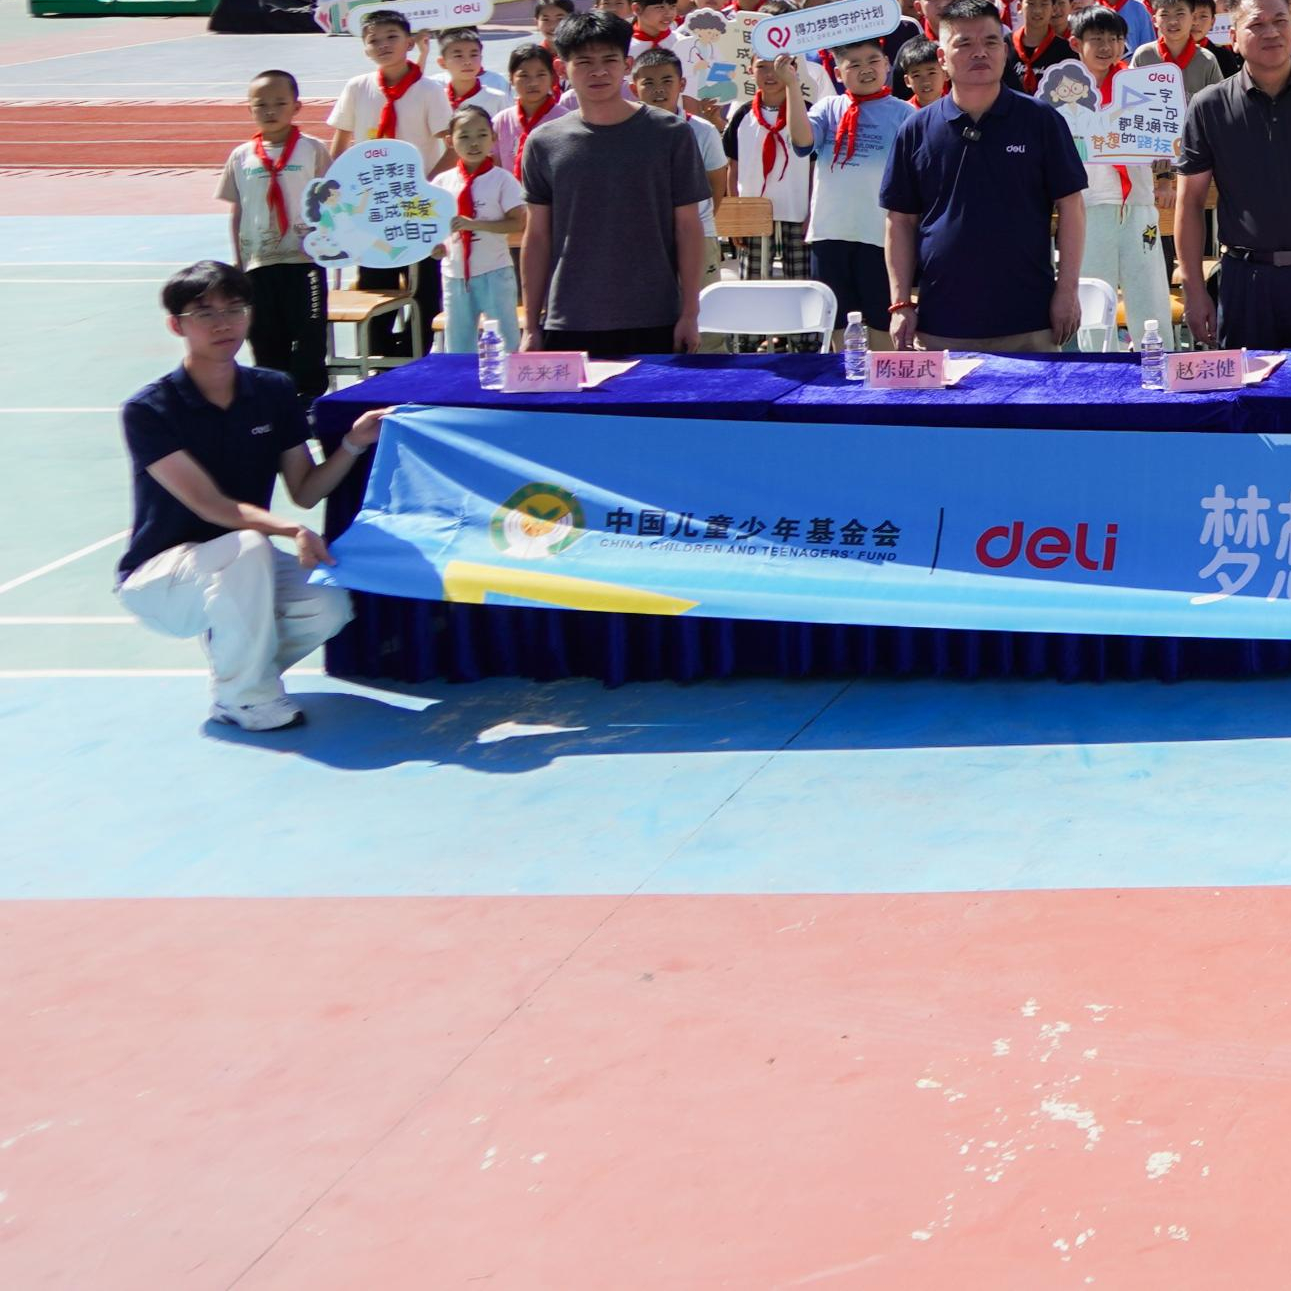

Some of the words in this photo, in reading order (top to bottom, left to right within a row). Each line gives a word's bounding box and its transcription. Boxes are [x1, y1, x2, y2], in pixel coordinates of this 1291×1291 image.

[453, 3, 480, 15] deli
[794, 5, 884, 36] 得力梦想守护计划
[1148, 72, 1174, 84] deli
[1144, 89, 1173, 104] 一字
[1149, 106, 1178, 120] 一句
[1119, 115, 1179, 134] 都是通往
[1006, 144, 1026, 154] deli
[1091, 131, 1172, 154] 梦想的路标
[364, 147, 387, 159] deli
[384, 220, 437, 243] 的自己
[875, 359, 937, 379] 陈显武
[1175, 357, 1236, 380] 赵宗健
[606, 507, 901, 547] 中国儿童少年基金会
[600, 539, 644, 549] CHINA
[649, 541, 722, 555] CHILDREN
[726, 544, 757, 556] AND
[857, 551, 897, 561] FUND
[975, 521, 1118, 571] deli
